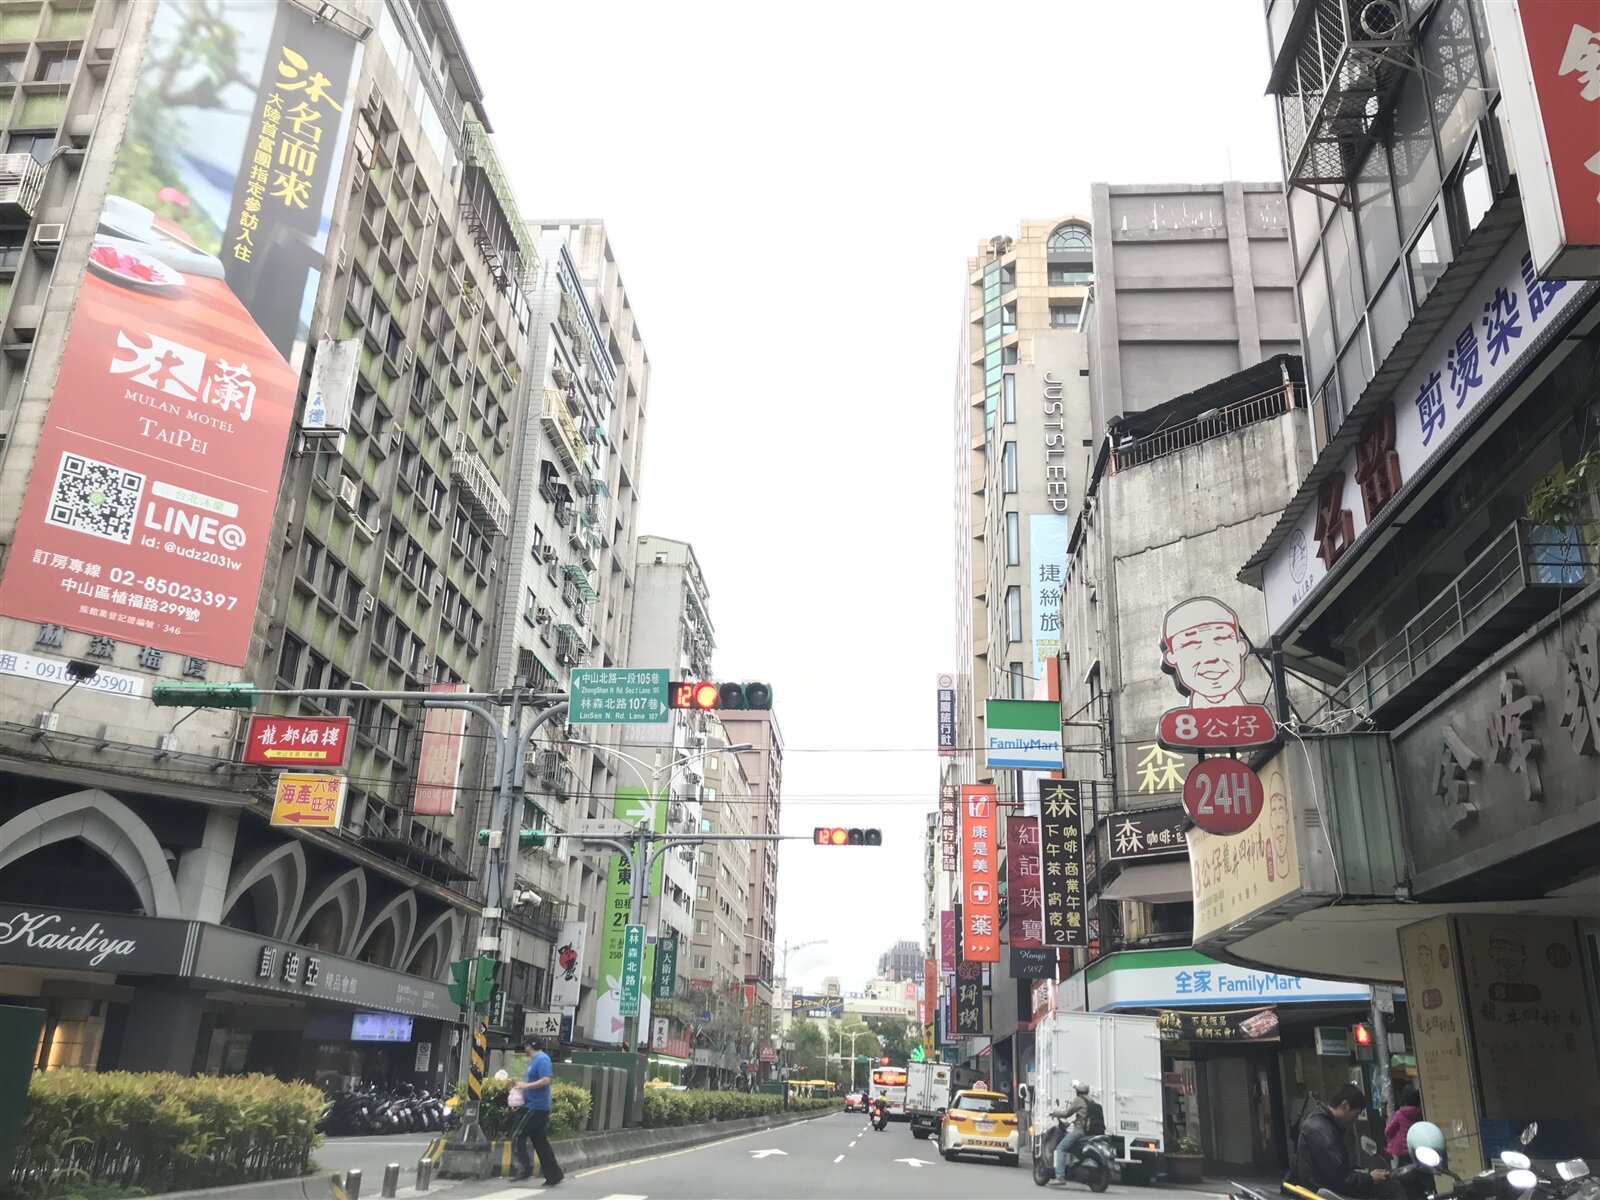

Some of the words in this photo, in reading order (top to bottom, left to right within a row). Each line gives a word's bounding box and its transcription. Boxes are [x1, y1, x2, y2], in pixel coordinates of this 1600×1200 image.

[269, 46, 344, 210] 沐名而來
[124, 389, 181, 416] MULAN
[186, 409, 235, 434] MOTEL
[144, 501, 246, 551] LINE@
[164, 541, 242, 571] @udz2031w
[32, 548, 101, 578] 訂房專線
[109, 567, 238, 611] 02-85023397
[61, 577, 201, 623] 中山區植福路299號
[1039, 563, 1060, 632] 捷絲旅
[581, 671, 660, 685] 中山北路一段105巷
[580, 697, 659, 710] 林森北路107巷
[257, 724, 340, 746] 龍都酒樓
[990, 737, 1059, 752] FamilyMart
[1174, 713, 1260, 740] 8公仔
[1136, 742, 1185, 794] 森
[279, 784, 312, 804] 海產
[1044, 784, 1078, 818] 森
[1195, 772, 1253, 815] 24H
[971, 825, 989, 874] 康是美
[1115, 818, 1144, 854] 森
[1018, 824, 1043, 941] 紅記珠寶
[0, 911, 136, 966] Kaidiya
[1053, 929, 1078, 942] 2F
[259, 946, 321, 987] 凱迪亞
[625, 934, 639, 986] 林森北路
[1175, 970, 1212, 994] 全家
[1218, 975, 1302, 995] FamilyMart
[544, 1016, 559, 1033] 松
